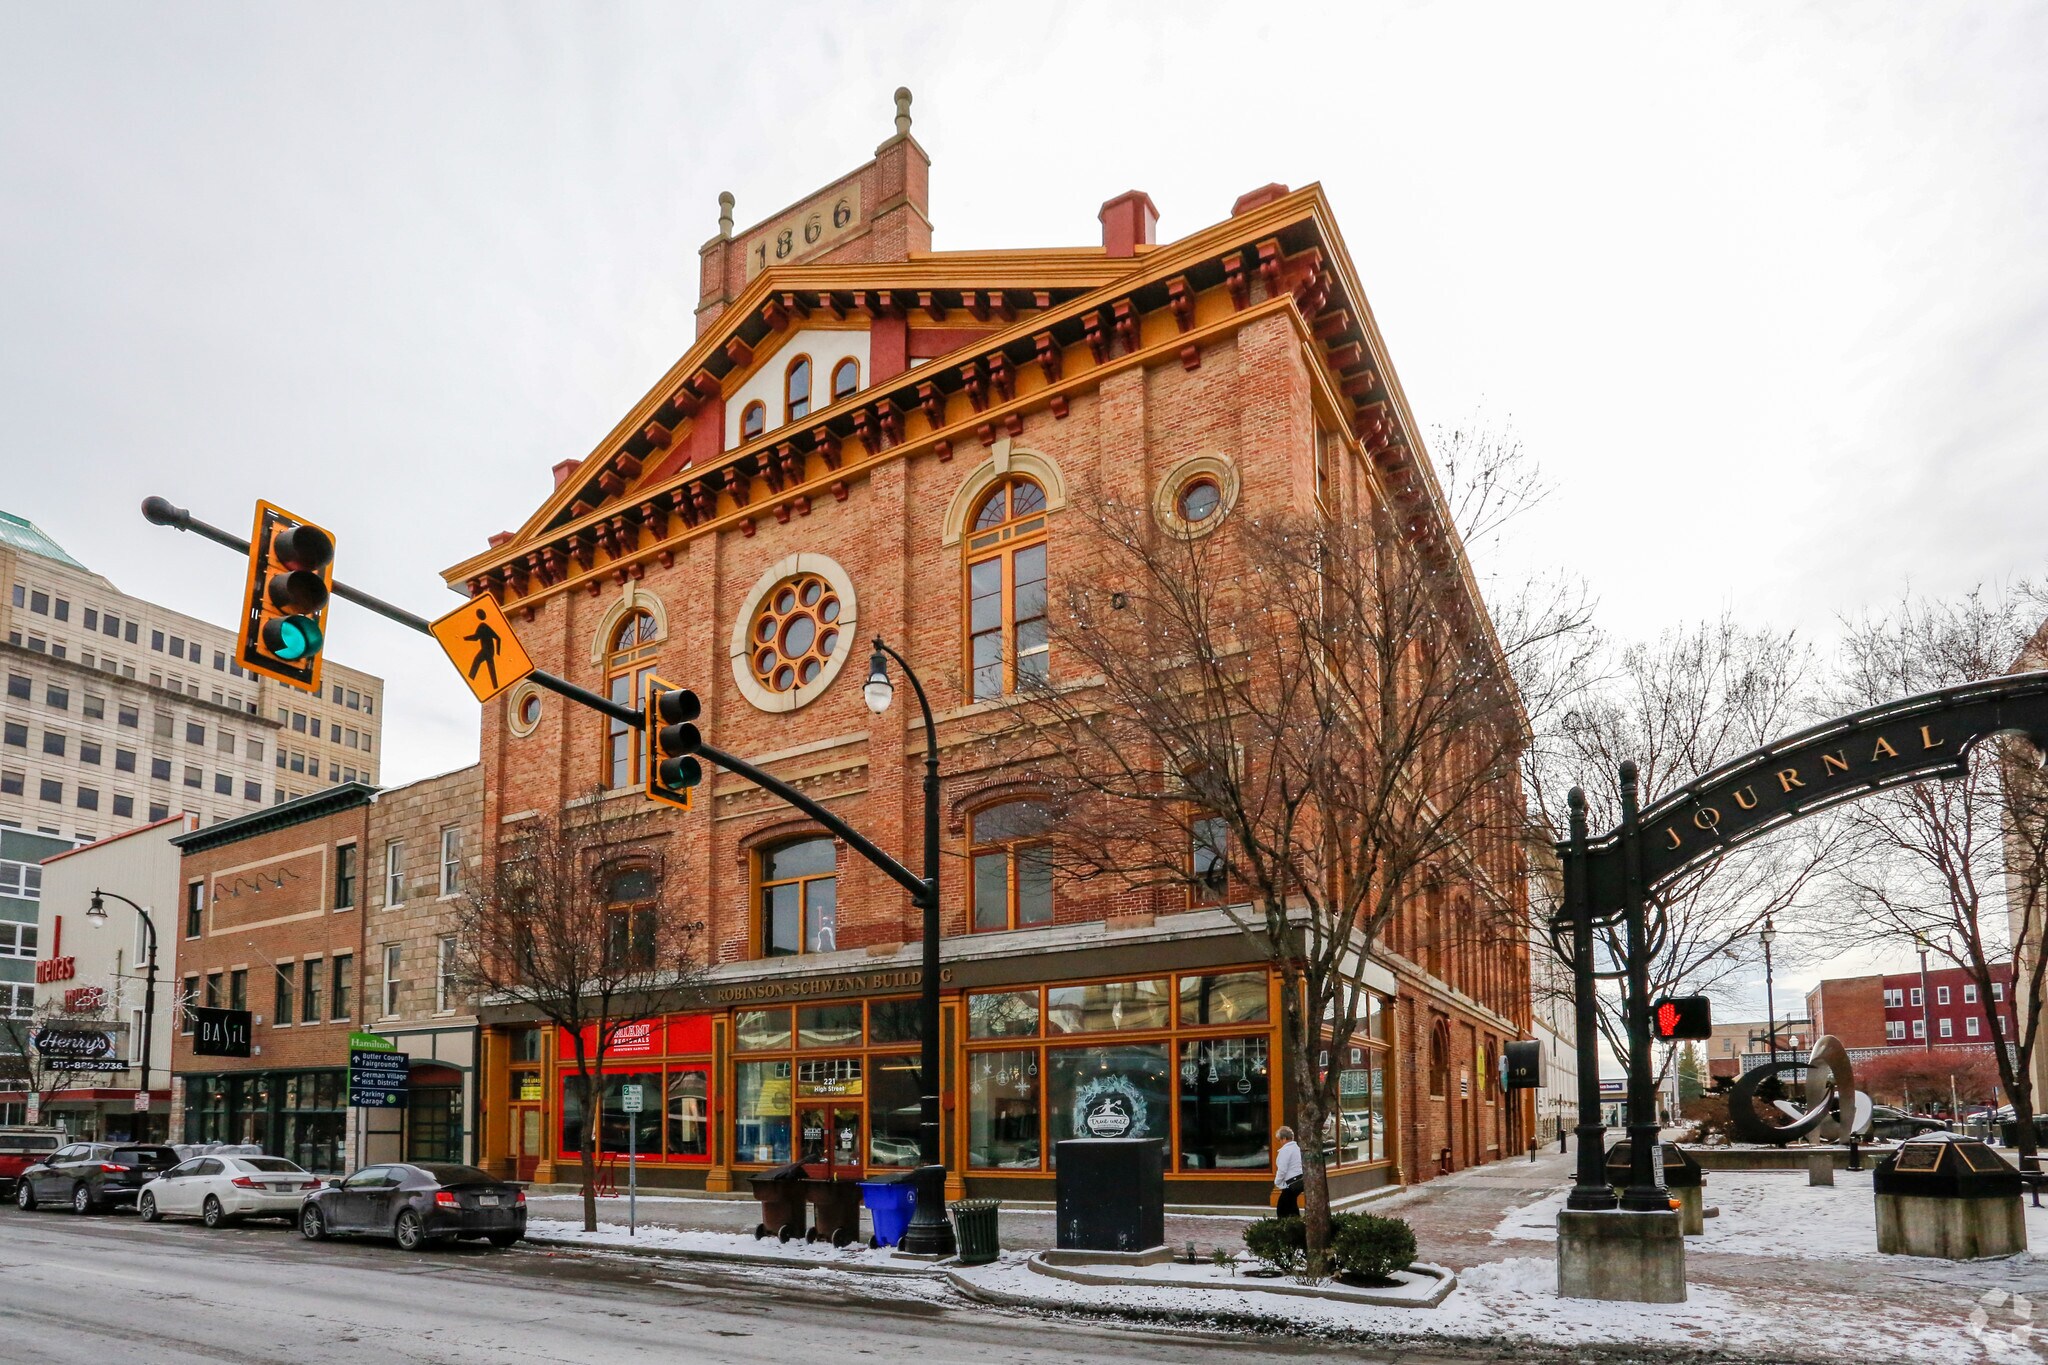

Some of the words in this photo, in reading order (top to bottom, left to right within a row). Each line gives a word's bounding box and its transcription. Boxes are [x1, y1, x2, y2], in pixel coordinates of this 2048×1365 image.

[755, 197, 851, 270] 1866
[1662, 724, 1945, 851] JOURNAL
[717, 974, 868, 1002] ROBINSON-SCHWENN
[872, 968, 953, 989] BUILDG
[613, 1023, 650, 1038] MIAMI
[40, 1031, 106, 1054] Henry's
[351, 1038, 390, 1049] Hamilton
[384, 1054, 404, 1062] County
[362, 1060, 398, 1068] Fairgrounds
[1516, 1067, 1526, 1076] 10
[387, 1073, 406, 1081] Village
[824, 1078, 836, 1086] 221
[361, 1091, 384, 1099] Parking
[624, 1086, 629, 1095] 2
